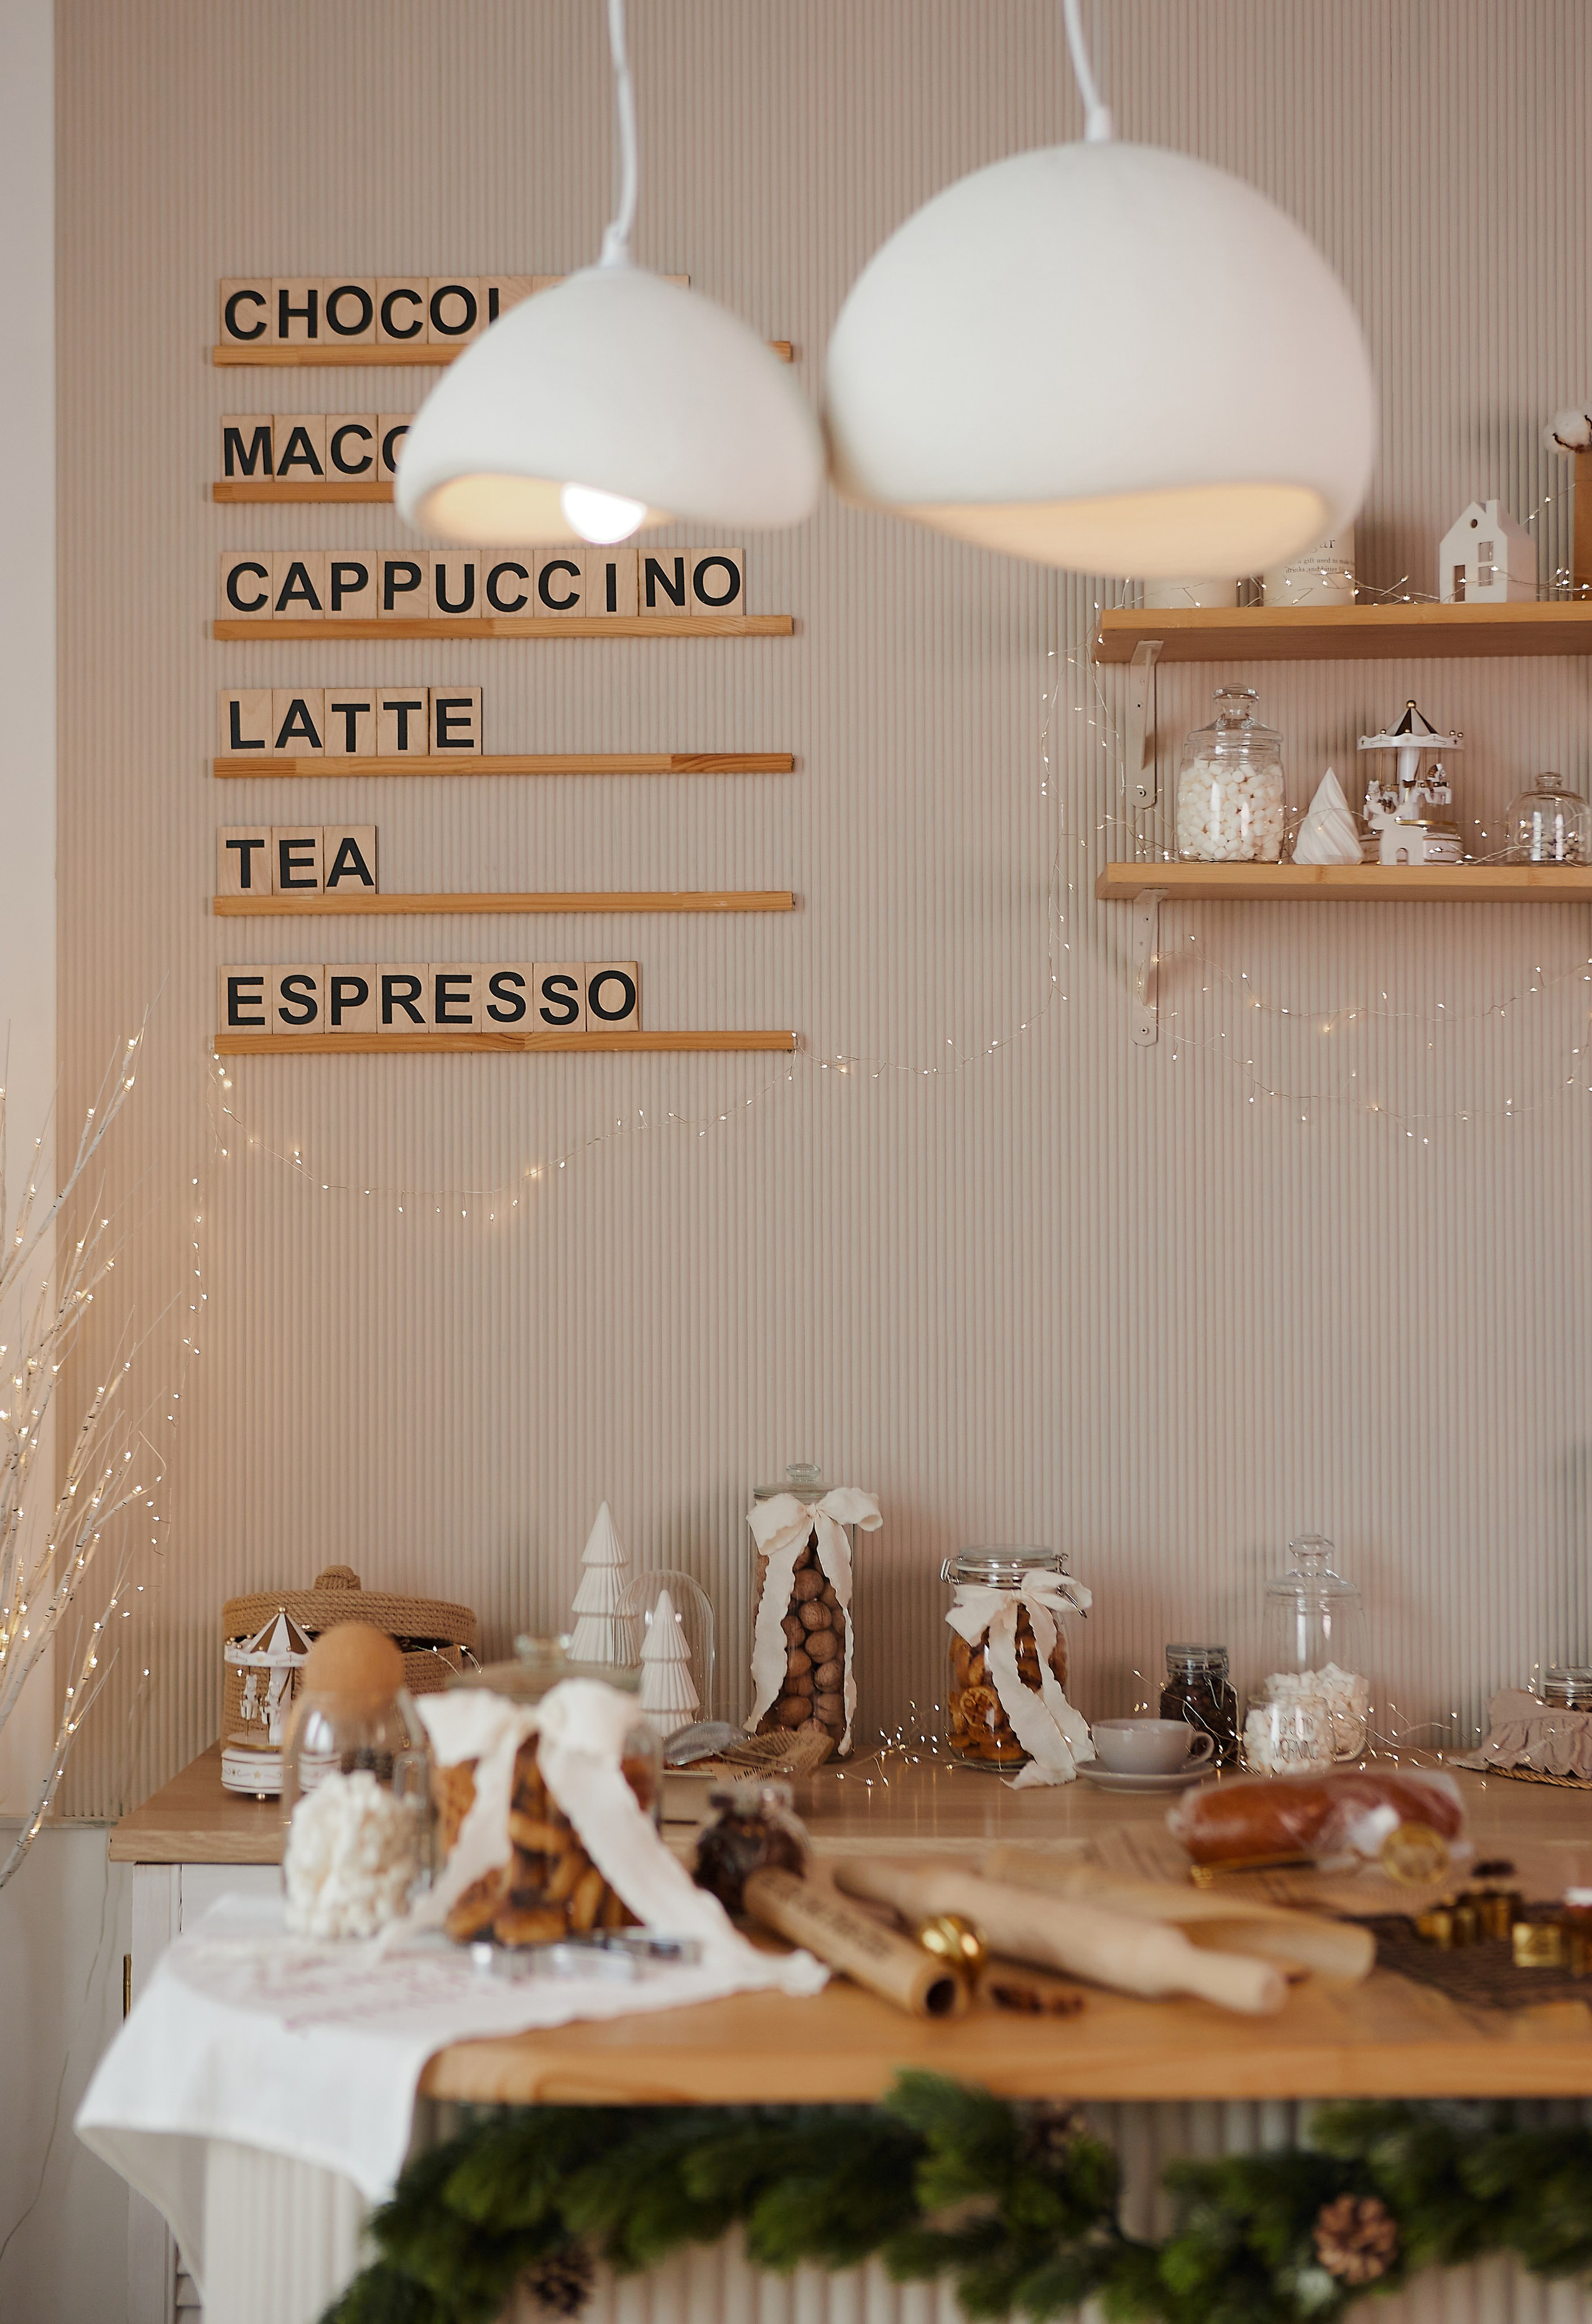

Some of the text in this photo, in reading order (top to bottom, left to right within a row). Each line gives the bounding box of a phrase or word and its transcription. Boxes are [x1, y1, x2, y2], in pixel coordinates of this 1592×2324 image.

[224, 285, 500, 341] CHOCOL
[223, 424, 411, 477] MACC
[226, 556, 741, 614] CAPPUCCINO
[229, 698, 474, 752] LATTE
[226, 838, 375, 889] TEA
[227, 970, 636, 1026] ESPRESSO
